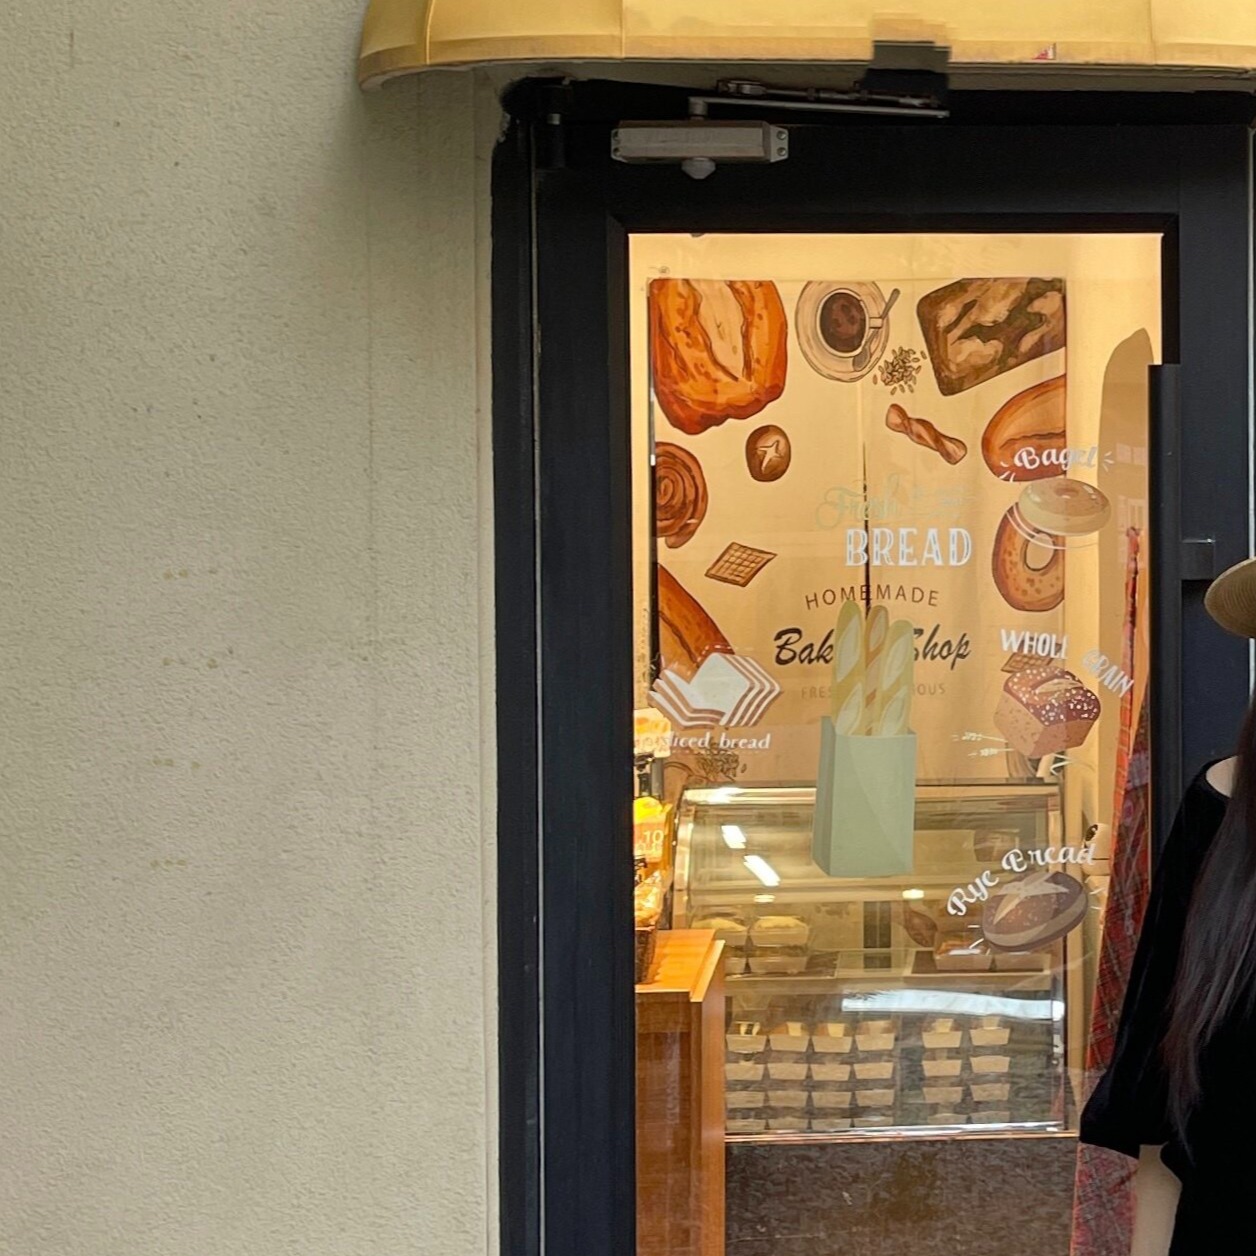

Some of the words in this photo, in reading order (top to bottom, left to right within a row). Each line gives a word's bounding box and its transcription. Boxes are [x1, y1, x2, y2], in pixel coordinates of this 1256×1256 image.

[1013, 446, 1098, 470] Bagel
[844, 527, 973, 567] BREAD
[805, 583, 940, 610] HOMEMADE
[773, 626, 835, 666] Bak
[719, 731, 771, 749] bread
[643, 829, 664, 846] 10
[946, 869, 1000, 916] Rye
[1001, 842, 1097, 873] Bread
